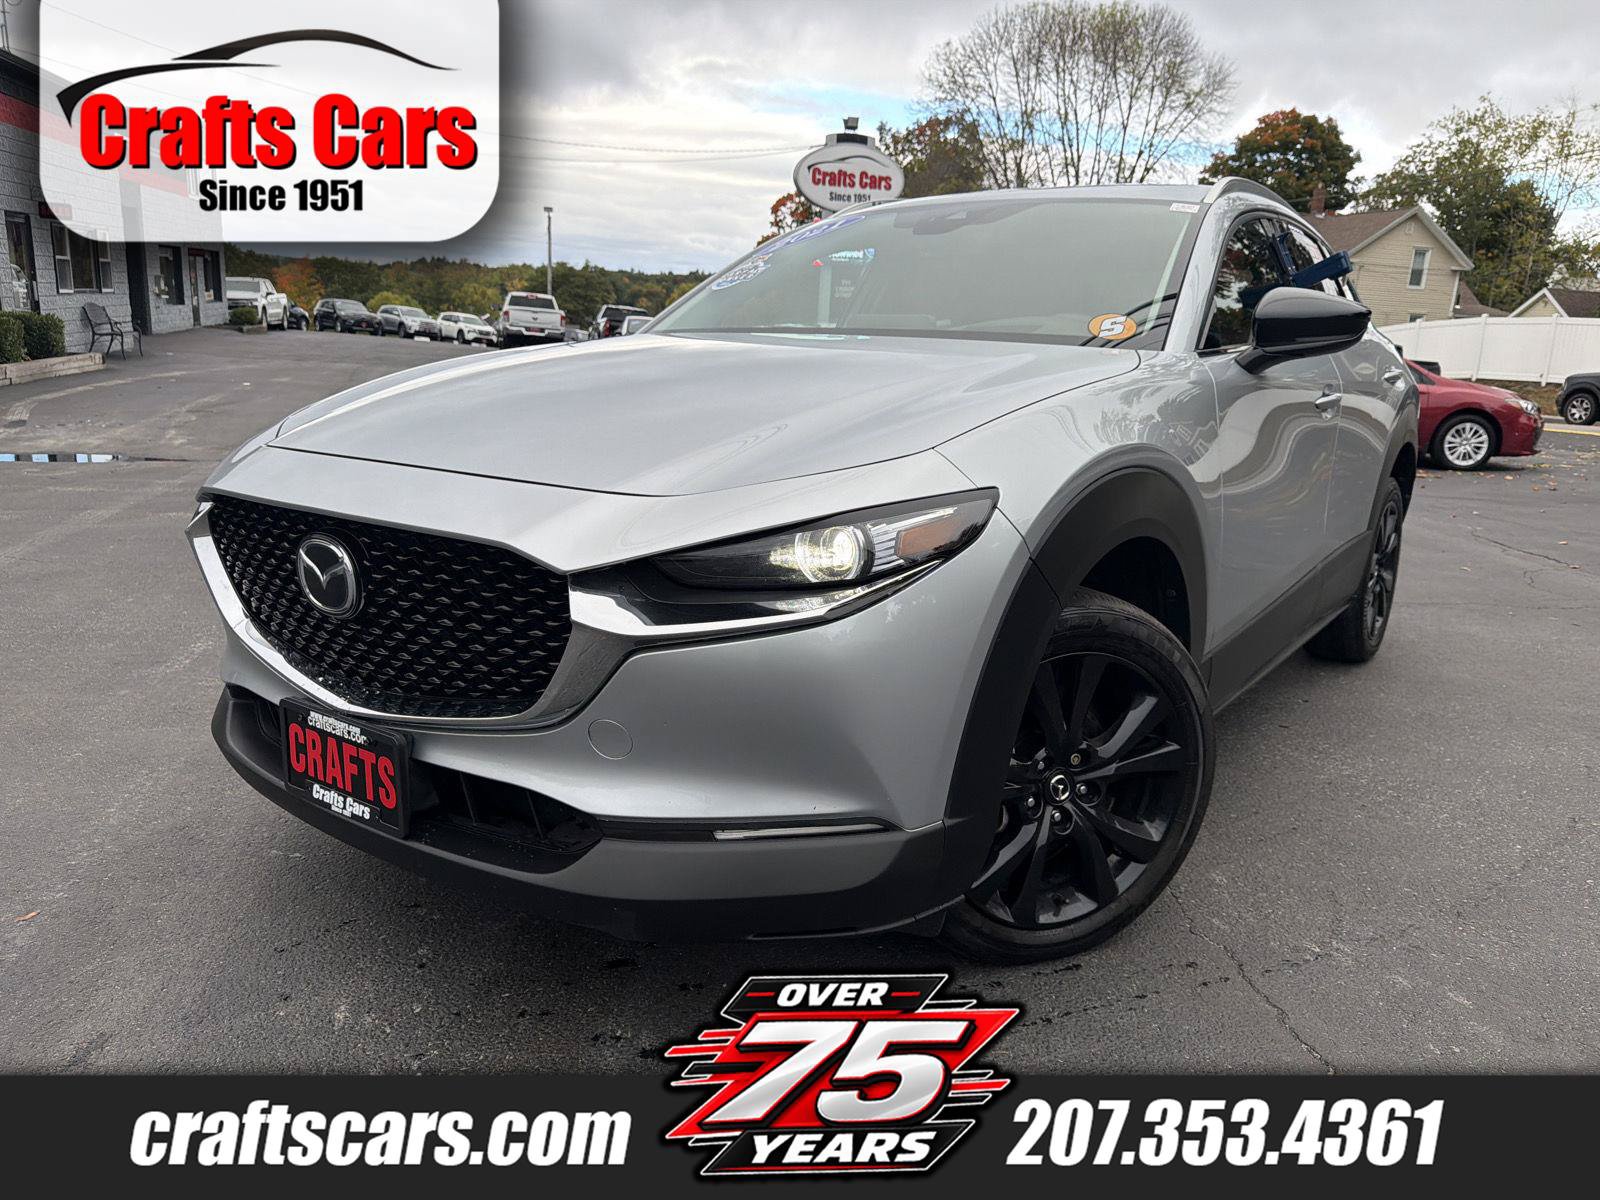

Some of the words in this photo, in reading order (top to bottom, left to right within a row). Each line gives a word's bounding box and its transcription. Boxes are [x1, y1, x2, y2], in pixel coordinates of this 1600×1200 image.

[811, 167, 856, 188] Crafts
[859, 170, 892, 191] Cars
[829, 191, 852, 202] Since
[288, 722, 397, 809] CRAFTS
[312, 783, 344, 809] Crafts
[345, 797, 371, 820] Cars
